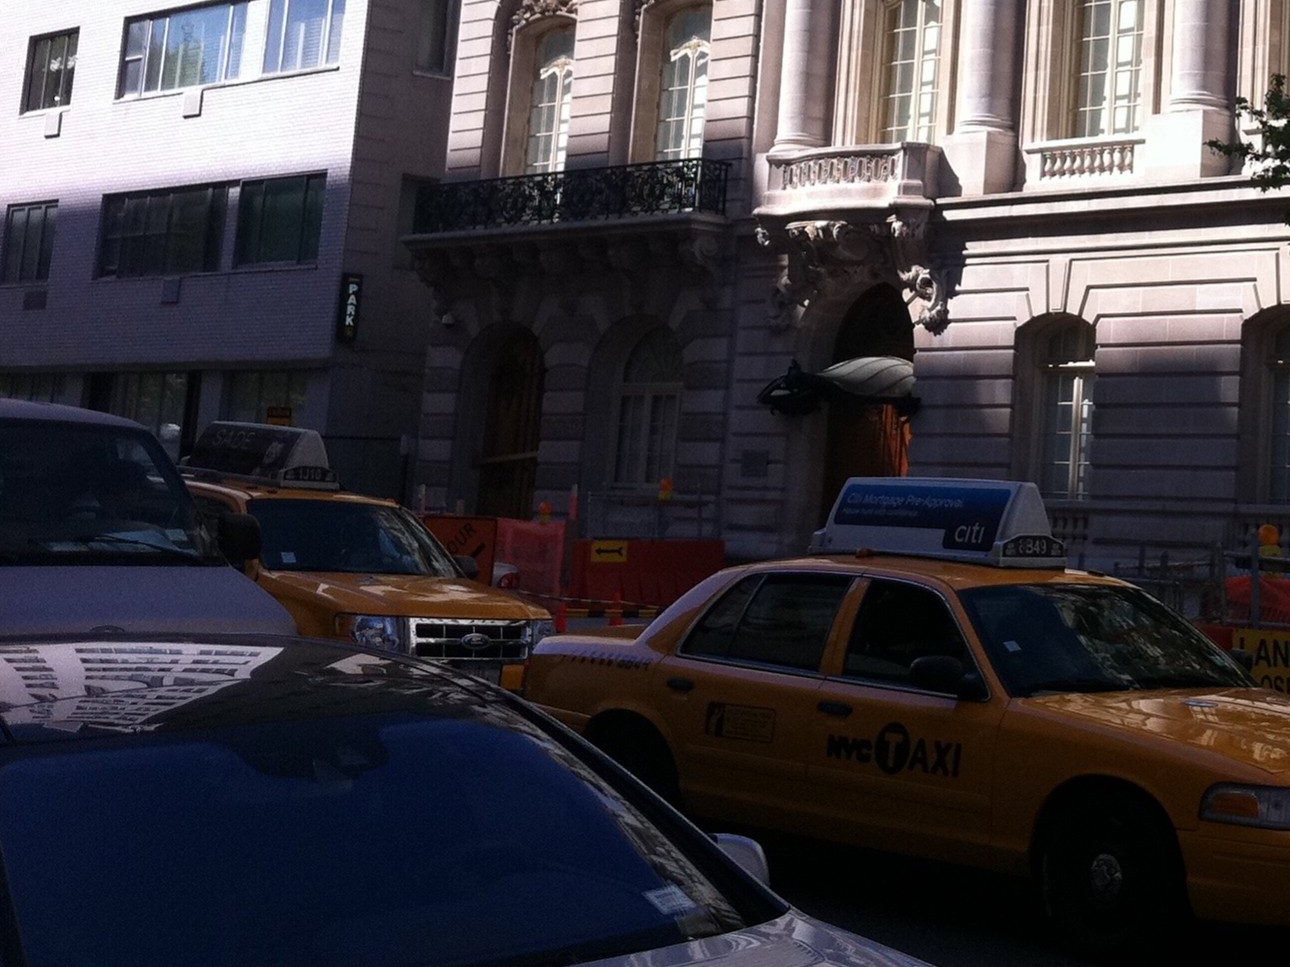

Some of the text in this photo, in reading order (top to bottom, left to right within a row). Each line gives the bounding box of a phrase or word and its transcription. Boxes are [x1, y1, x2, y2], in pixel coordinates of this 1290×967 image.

[345, 283, 359, 326] PARK
[446, 523, 477, 555] OUR
[954, 521, 985, 544] citi
[826, 734, 871, 763] NYC
